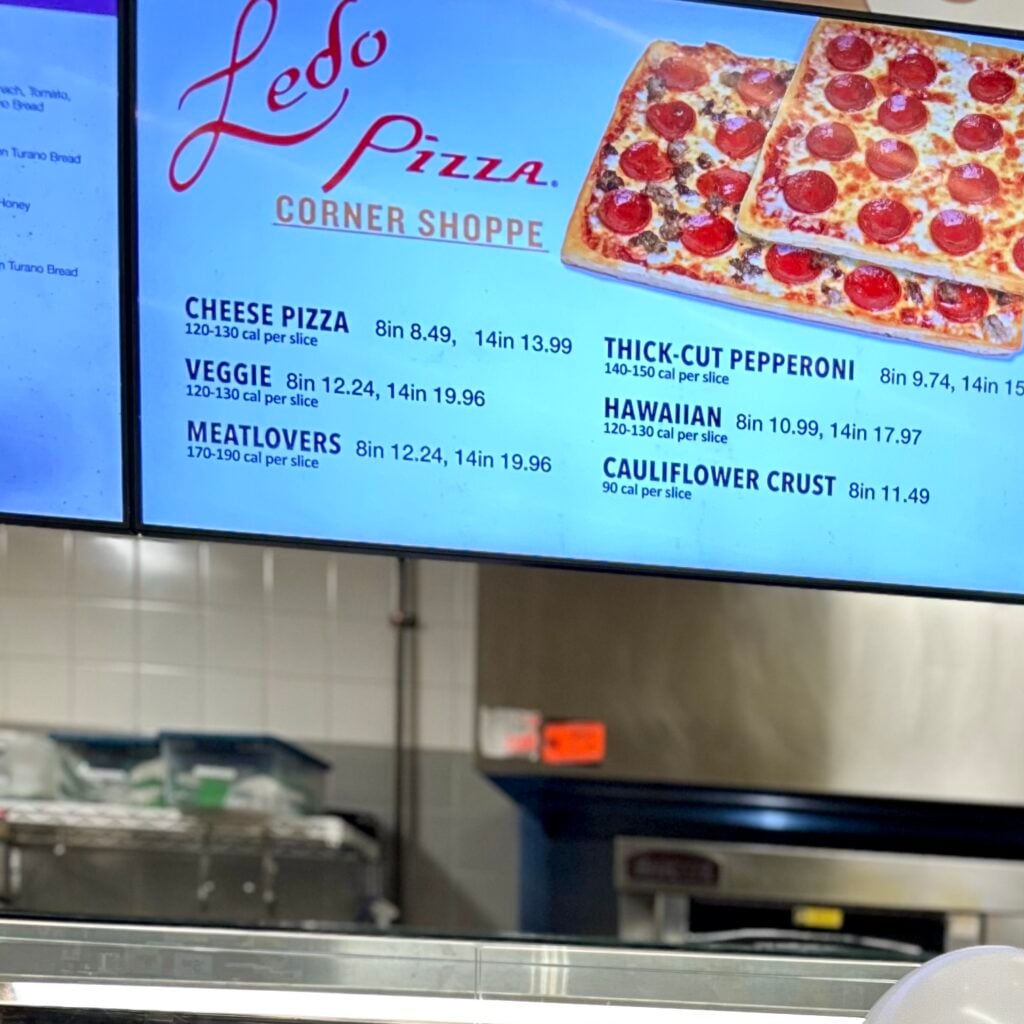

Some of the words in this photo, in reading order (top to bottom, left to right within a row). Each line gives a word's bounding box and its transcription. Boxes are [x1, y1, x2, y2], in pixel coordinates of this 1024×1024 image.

[169, 0, 387, 192] Ledo
[322, 114, 549, 193] Pizza
[275, 195, 406, 235] CORNER
[418, 210, 544, 248] SHOPPE
[185, 296, 273, 326] CHEESE
[282, 306, 349, 333] PIZZA
[375, 319, 404, 339] 8in
[410, 323, 457, 346] 8.49,
[475, 330, 514, 350] 14in
[521, 334, 572, 354] 13.99
[185, 323, 239, 339] 120-130
[242, 326, 261, 341] cal
[264, 331, 286, 346] per
[290, 330, 318, 346] slice
[185, 358, 272, 388] VEGGIE
[286, 373, 315, 393] 8in
[322, 376, 380, 400] 12.24,
[387, 382, 427, 402] 14in
[433, 387, 486, 407] 19.96
[604, 336, 724, 369] THICK-CUT
[730, 349, 855, 381] PEPPERONI
[880, 368, 906, 386] 8in
[913, 371, 955, 393] 9.74,
[961, 375, 999, 394] 14in
[604, 362, 655, 379] 140-150
[657, 367, 675, 382] cal
[678, 371, 700, 386] per
[702, 370, 729, 385] slice
[185, 384, 239, 400] 120-130
[242, 388, 261, 403] cal
[264, 393, 286, 408] per
[290, 393, 318, 408] slice
[603, 422, 654, 438] 120-130
[657, 426, 674, 440] cal
[677, 431, 699, 446] per
[701, 429, 727, 445] slice
[604, 396, 722, 429] HAWAIIAN
[736, 414, 763, 432] 8in
[769, 417, 824, 439] 10.99,
[830, 422, 867, 441] 14in
[873, 426, 922, 446] 17.97
[187, 420, 341, 455] MEATLOVERS
[355, 440, 384, 460] 8in
[390, 443, 447, 466] 12.24,
[454, 448, 494, 468] 14in
[500, 453, 552, 473] 19.96
[187, 446, 241, 462] 170-190
[244, 450, 262, 464] cal
[266, 454, 288, 469] per
[290, 454, 318, 470] slice
[602, 456, 759, 491] CAULIFLOWER
[767, 470, 836, 497] CRUST
[848, 482, 875, 500] 8in
[881, 485, 930, 504] 11.49
[602, 481, 617, 494] 90
[620, 482, 638, 497] cal
[641, 487, 662, 501] per
[665, 485, 691, 500] slice
